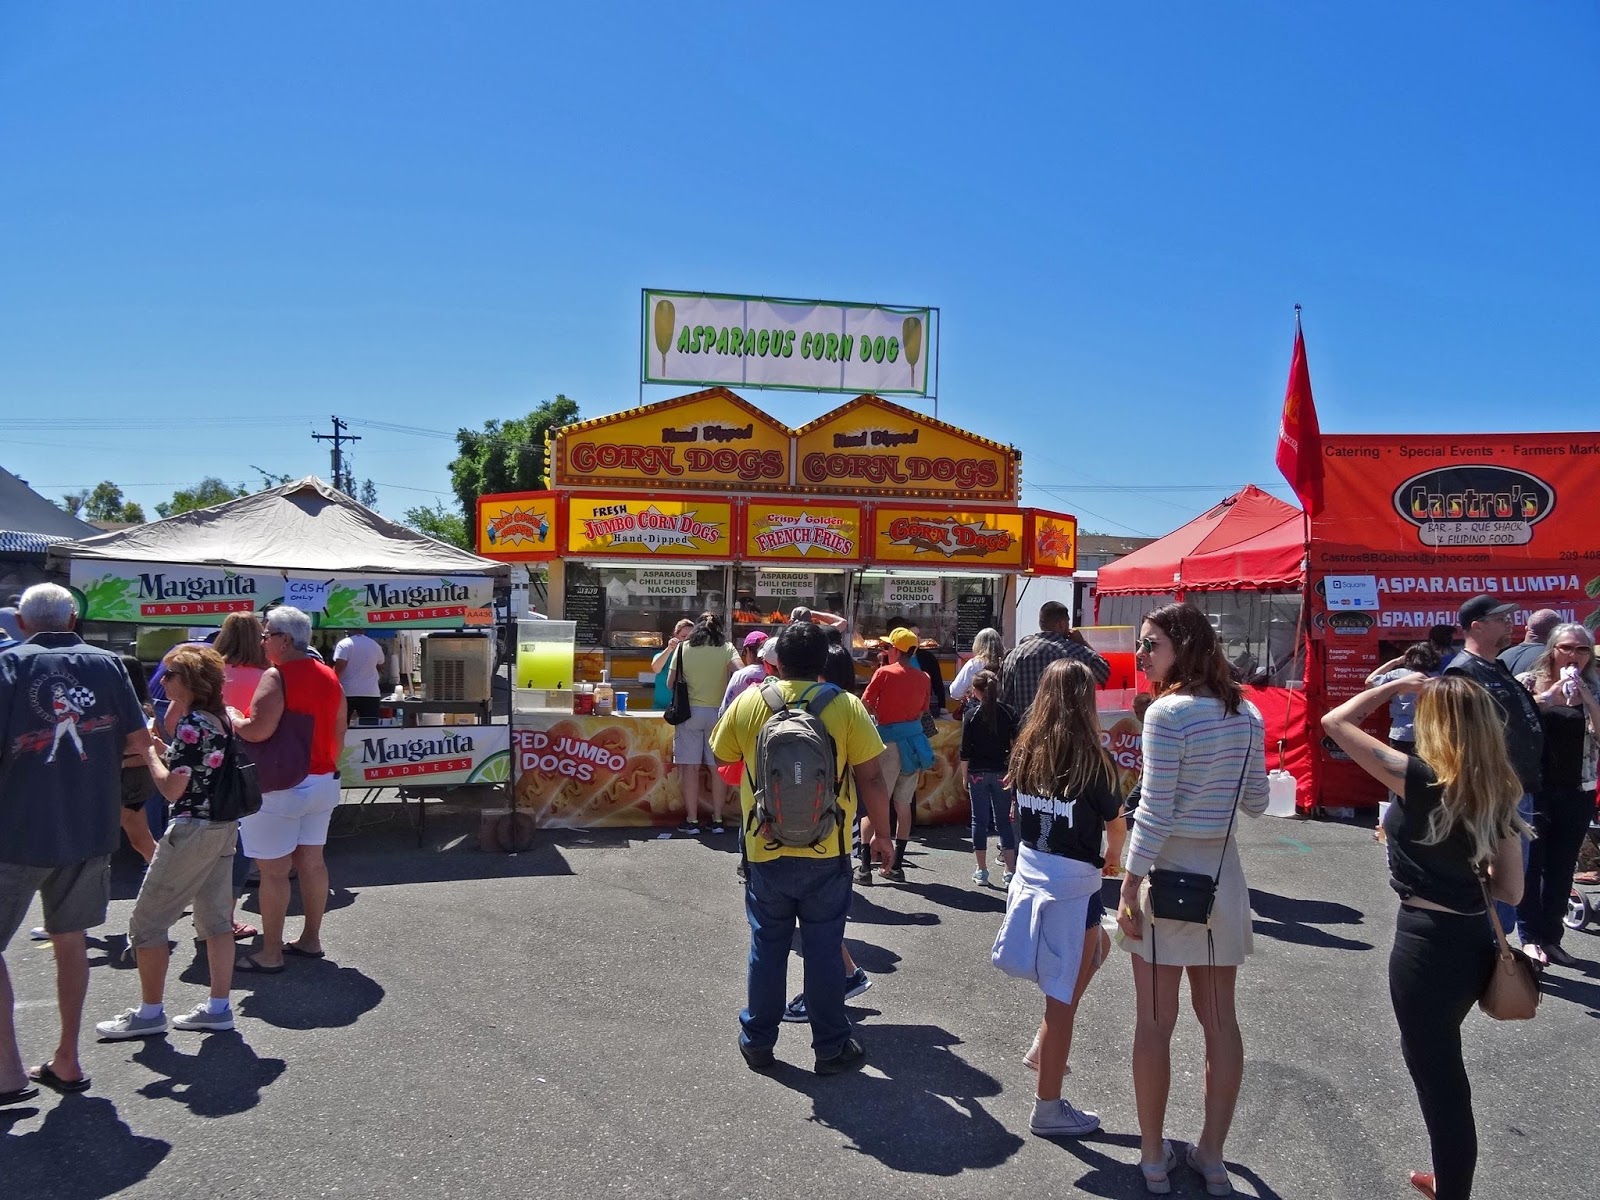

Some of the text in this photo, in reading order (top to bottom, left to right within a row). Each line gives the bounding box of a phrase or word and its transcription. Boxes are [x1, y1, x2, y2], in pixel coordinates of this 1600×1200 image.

[676, 325, 899, 364] ASPARAGUS CORN DOG
[703, 424, 754, 443] Dipped
[871, 429, 919, 448] Dipped
[571, 442, 784, 480] CORN DOGS
[1325, 444, 1600, 459] Catering Special Events Farmers Mark
[803, 452, 998, 489] CORN DOGS
[593, 504, 628, 518] FRESH
[1410, 485, 1538, 518] Castro's
[583, 511, 721, 544] JUMBO CORN DOGS
[767, 514, 844, 525] Crispy Golden
[1427, 523, 1446, 533] BAR
[1471, 523, 1490, 532] QUE
[1493, 522, 1523, 531] SHACK
[614, 533, 688, 546] Hand-Dipped
[755, 527, 854, 556] FRENCH FRIES
[889, 518, 952, 546] CORN
[1447, 535, 1486, 544] FILIPINO
[1489, 534, 1515, 543] FOOD
[137, 572, 259, 601] Margarita
[290, 583, 325, 593] CASH
[647, 586, 688, 594] NACHOS
[1377, 574, 1580, 593] ASPARAGUS LUMPIA
[364, 582, 470, 608] Margarita
[890, 593, 934, 601] CORNDOG
[146, 602, 250, 614] MADNESS
[373, 607, 464, 621] MADNESS
[360, 733, 475, 763] Margarita
[553, 737, 625, 771] JUMBO
[370, 760, 467, 778] MADNESS
[522, 753, 594, 781] DOGS
